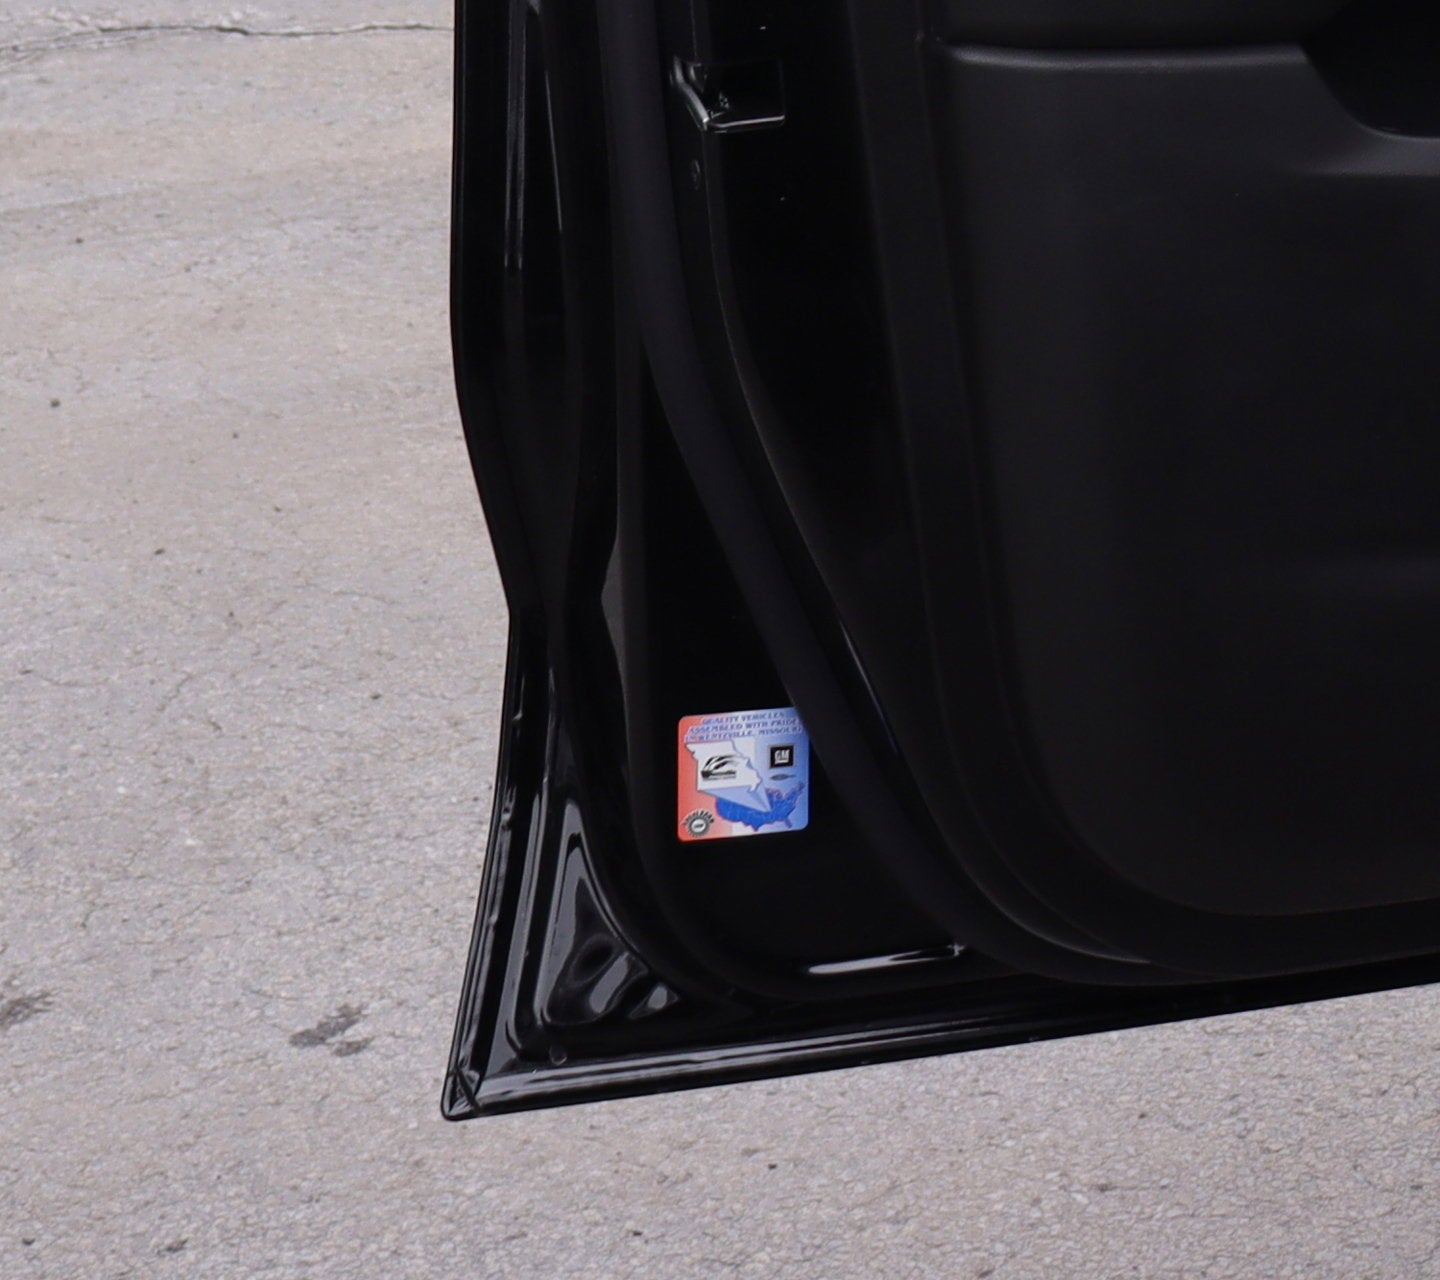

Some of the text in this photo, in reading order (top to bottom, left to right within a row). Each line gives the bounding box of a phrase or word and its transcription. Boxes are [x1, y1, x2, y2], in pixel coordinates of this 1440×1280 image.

[702, 712, 784, 725] QUALITY VEHICLES
[774, 749, 791, 765] GM
